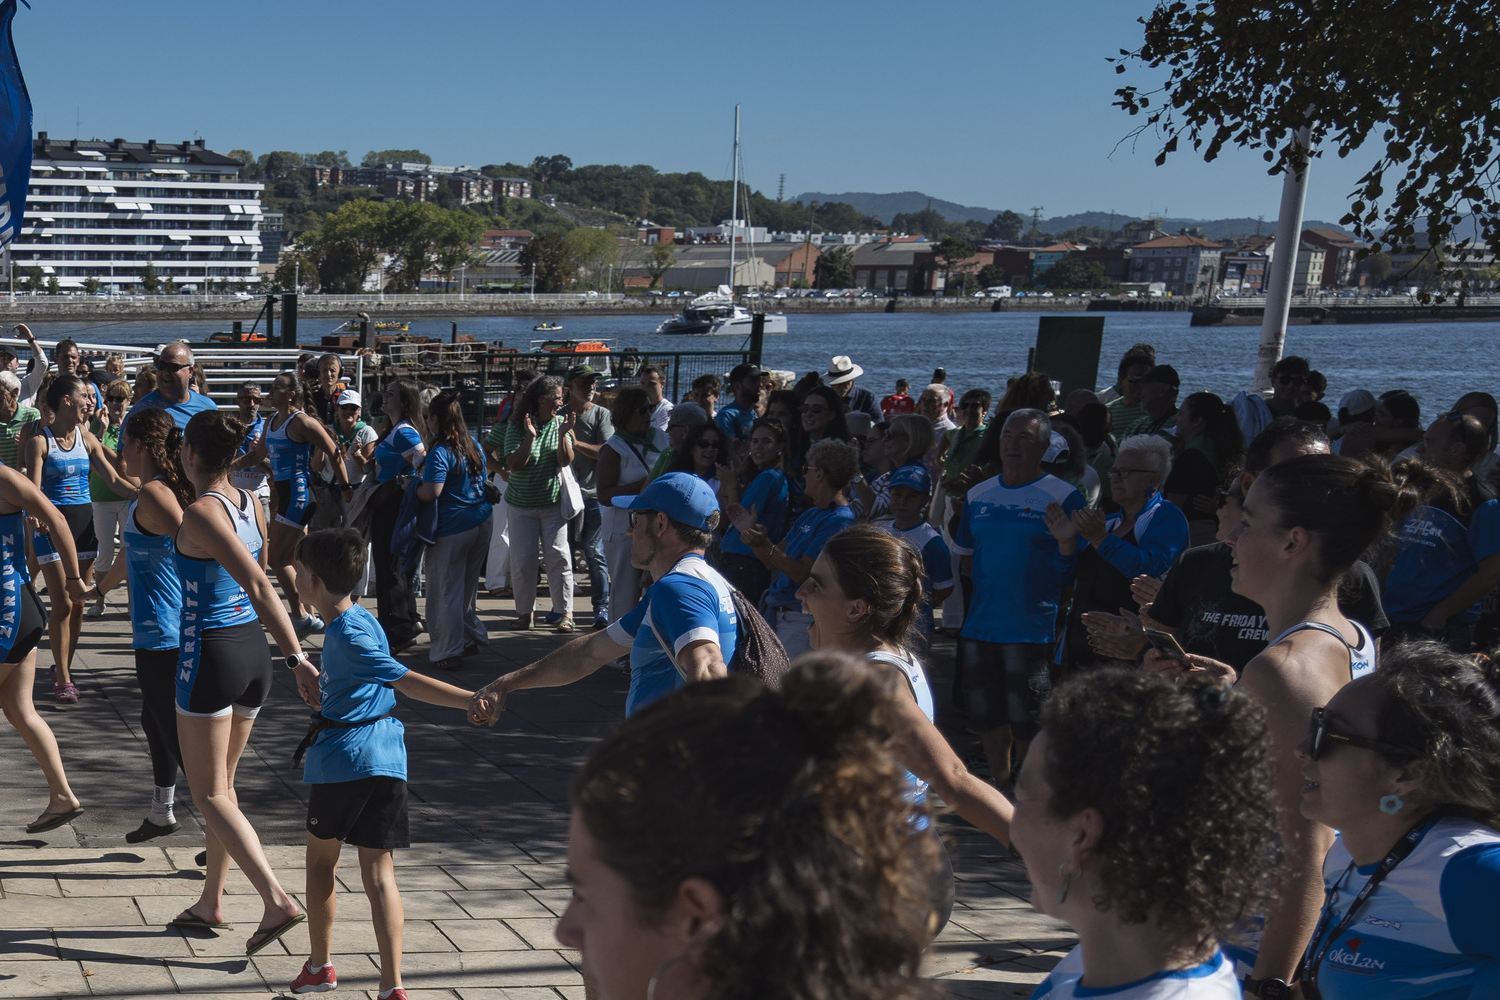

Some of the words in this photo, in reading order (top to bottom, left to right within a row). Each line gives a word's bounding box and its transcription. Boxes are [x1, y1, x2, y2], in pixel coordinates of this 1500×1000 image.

[0, 533, 16, 639] ZARAUTZ
[180, 579, 198, 684] ZARAUTZ
[1202, 611, 1220, 624] THE
[1221, 613, 1267, 629] FRIDAY
